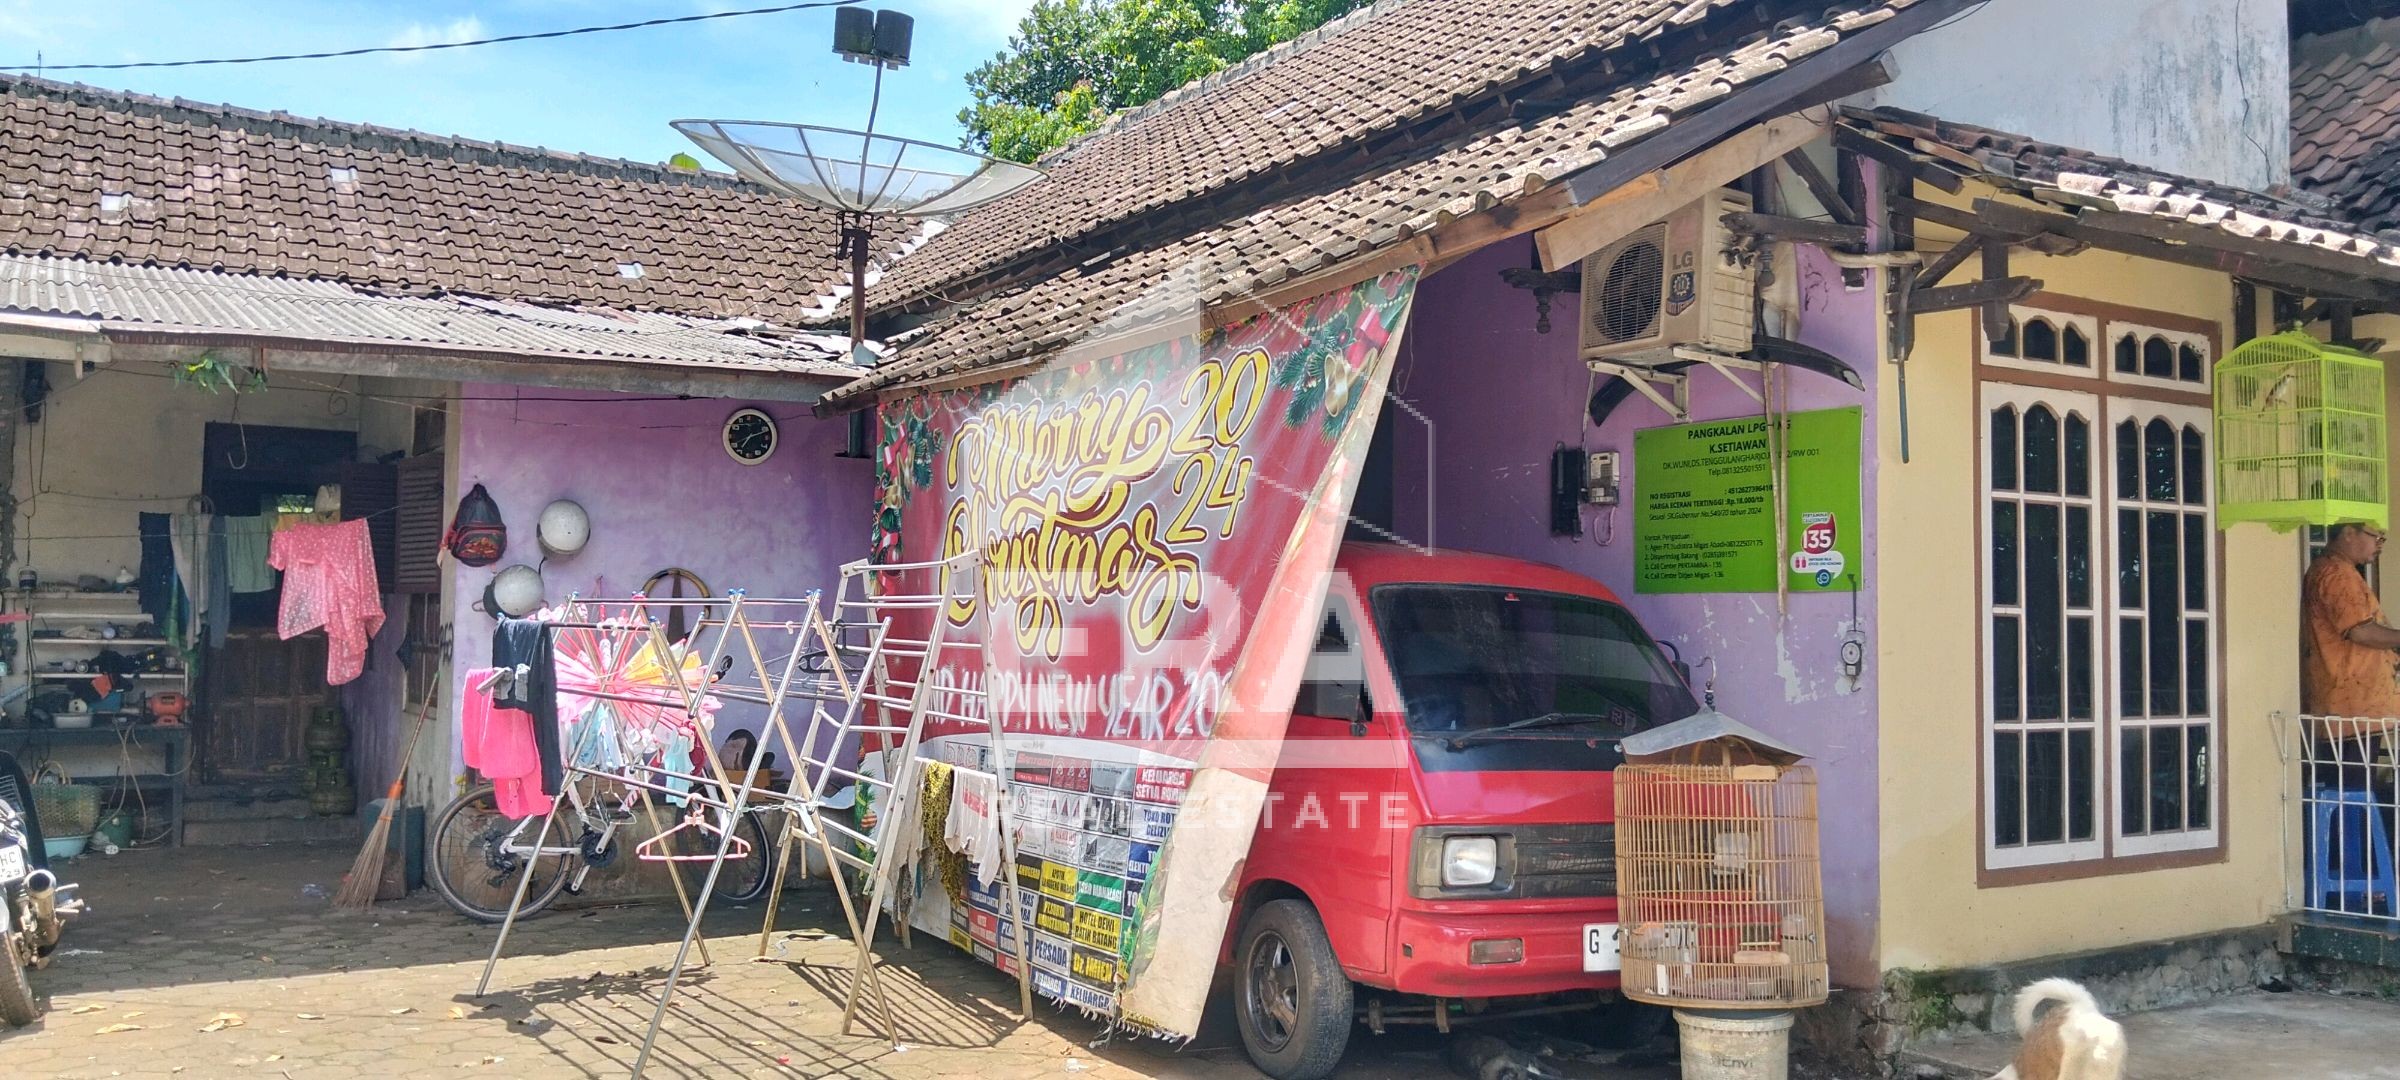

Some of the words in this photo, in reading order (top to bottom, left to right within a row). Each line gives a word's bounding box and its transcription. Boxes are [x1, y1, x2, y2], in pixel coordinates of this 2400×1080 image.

[1672, 251, 1694, 270] LG
[944, 381, 1173, 517] Merry
[1170, 347, 1271, 453] 20
[1688, 425, 1744, 440] PANGKALAN
[1747, 421, 1766, 434] LPG
[1709, 438, 1766, 454] K.SETIAWAN
[1803, 529, 1832, 549] 135
[938, 490, 1201, 663] Christmas
[1164, 443, 1254, 544] 24
[1037, 670, 1093, 735] NEW
[1096, 667, 1175, 741] YEAR
[1079, 910, 1097, 928] HOTEL
[1092, 933, 1117, 950] BATANG
[1589, 928, 1600, 954] G
[1035, 938, 1068, 969] PERSADA
